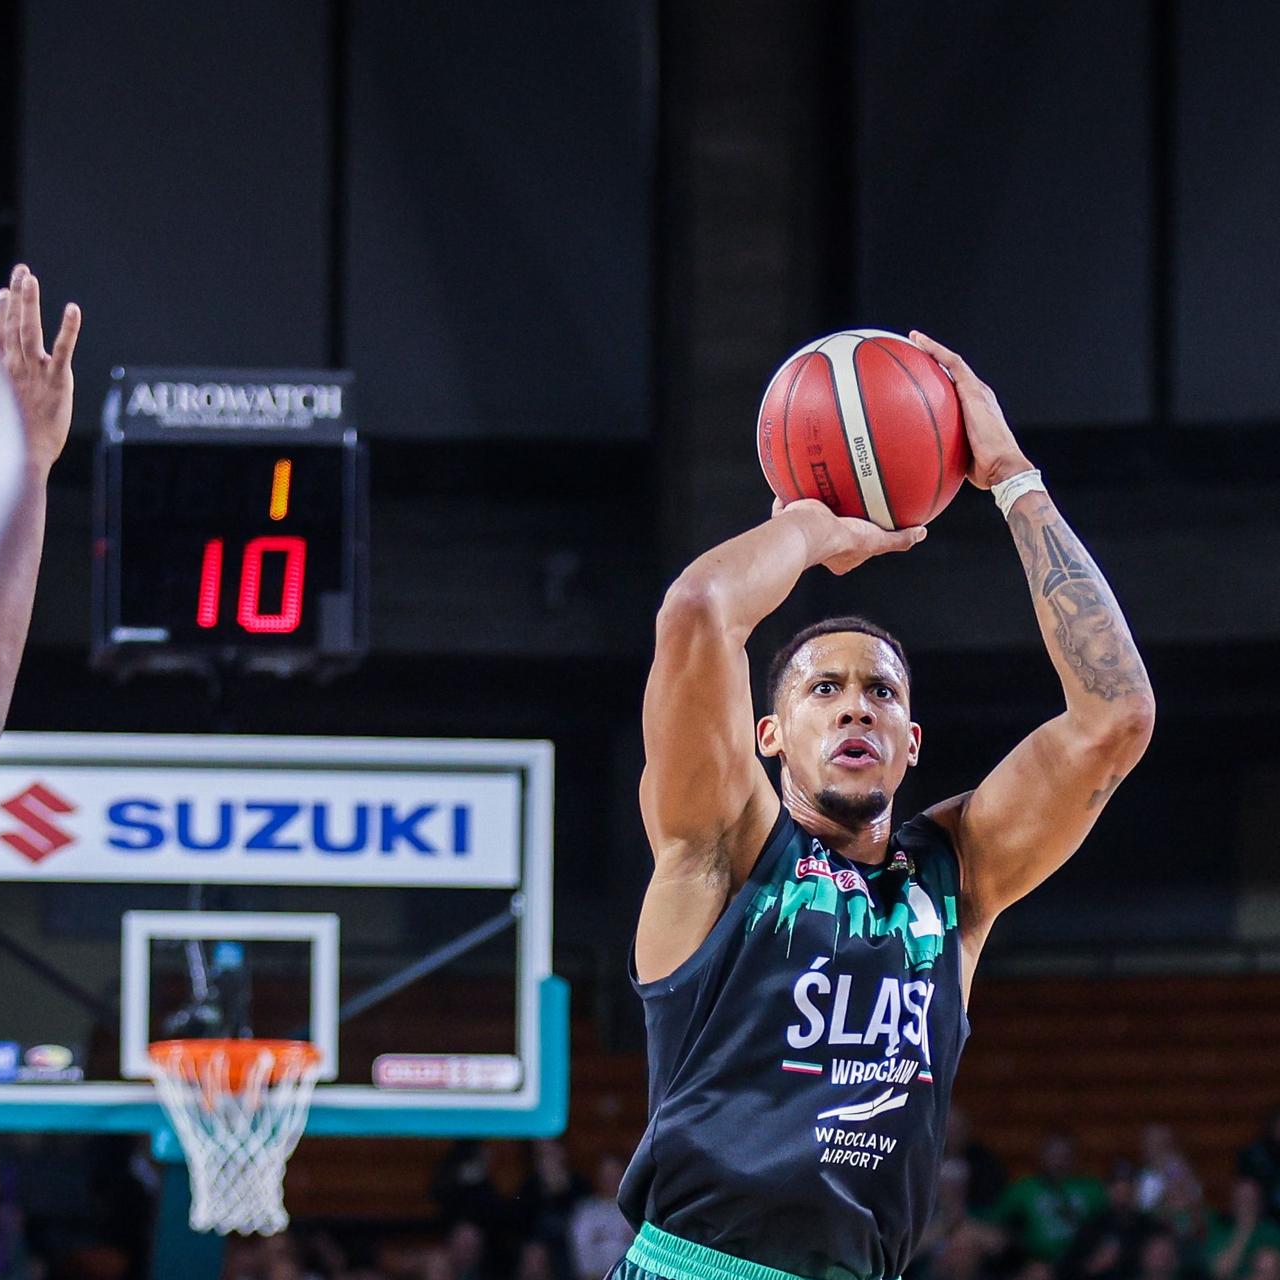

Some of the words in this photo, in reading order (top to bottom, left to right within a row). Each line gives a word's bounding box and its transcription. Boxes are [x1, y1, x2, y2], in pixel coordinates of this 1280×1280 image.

[269, 458, 292, 521] 1
[197, 536, 307, 632] 10
[106, 798, 473, 856] SUZUKI
[814, 1126, 897, 1154] WROCLAW
[820, 1147, 884, 1170] AIRPORT
